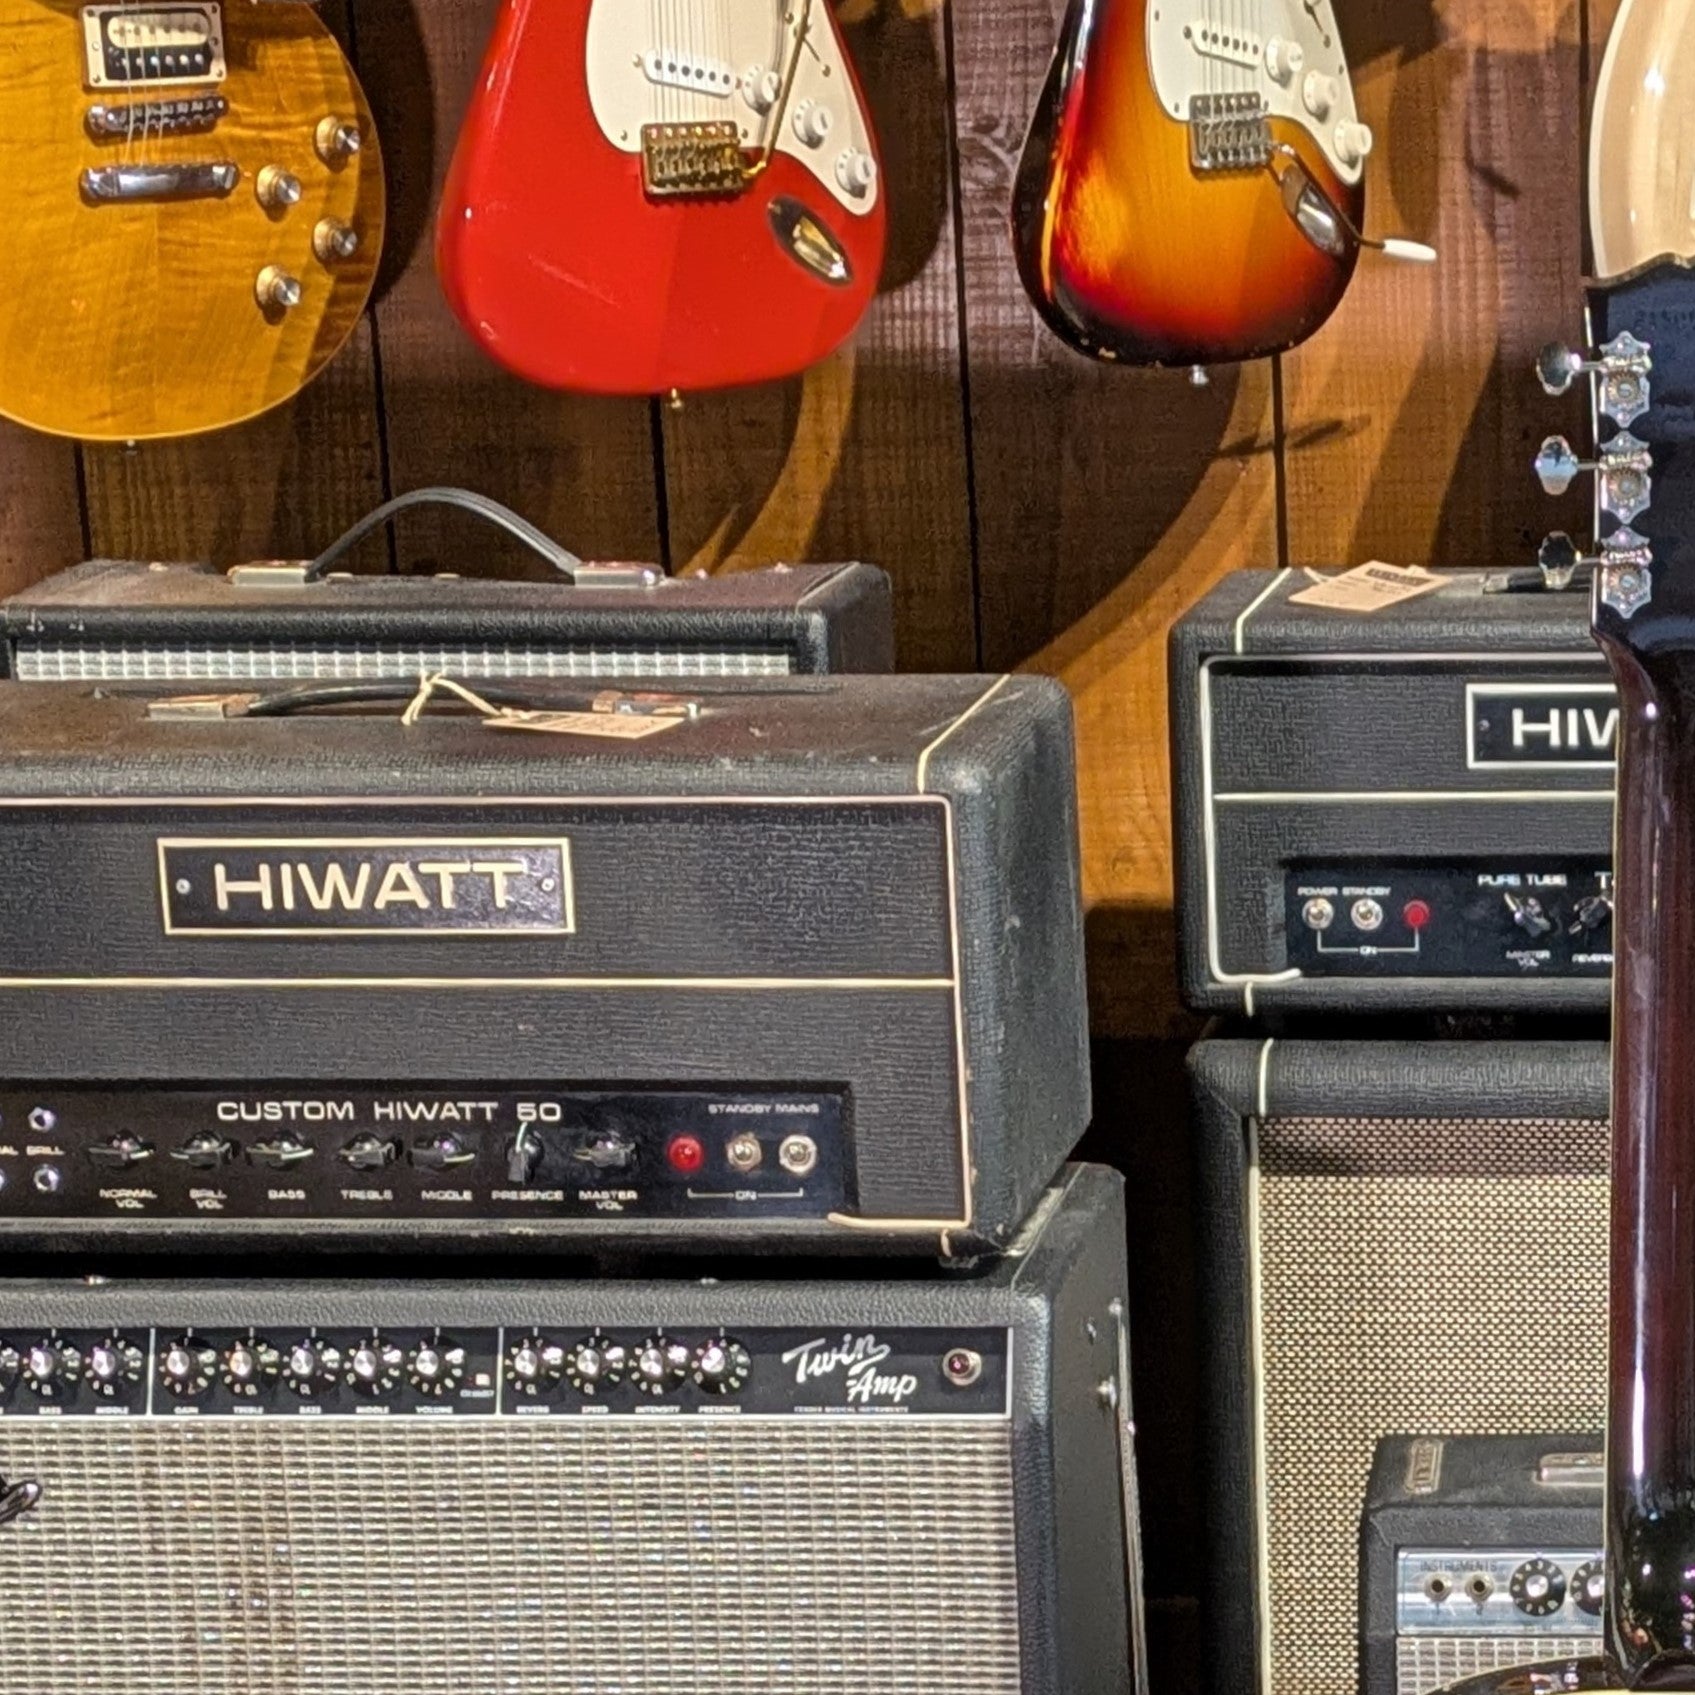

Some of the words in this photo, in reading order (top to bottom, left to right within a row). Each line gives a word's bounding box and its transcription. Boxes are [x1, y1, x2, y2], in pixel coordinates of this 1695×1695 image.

[213, 860, 530, 911] HIWATT
[1477, 874, 1521, 887] PURE
[1526, 874, 1567, 887] TUBE
[1297, 886, 1338, 897] POWER
[1342, 886, 1391, 897] STANDBY
[216, 1101, 354, 1121] CUSTOM
[373, 1101, 498, 1121] HIWATT
[516, 1102, 562, 1122] 50
[708, 1104, 771, 1114] STANDBY
[775, 1104, 820, 1113] MAINS
[99, 1188, 157, 1199] NORMAL
[267, 1189, 306, 1199] BASS
[340, 1189, 393, 1200] TREBLE
[421, 1189, 473, 1200] MIDDLE
[491, 1189, 564, 1200] PRESENCE
[578, 1190, 638, 1200] MASTER
[115, 1199, 144, 1209] VOL
[195, 1199, 223, 1209] VOL
[595, 1200, 623, 1210] VOL
[782, 1333, 891, 1384] Twin
[845, 1366, 918, 1403] Amp
[38, 1405, 63, 1415] BASS
[698, 1405, 742, 1415] PRESENCE
[1420, 1561, 1498, 1572] INSTRUMENTS
